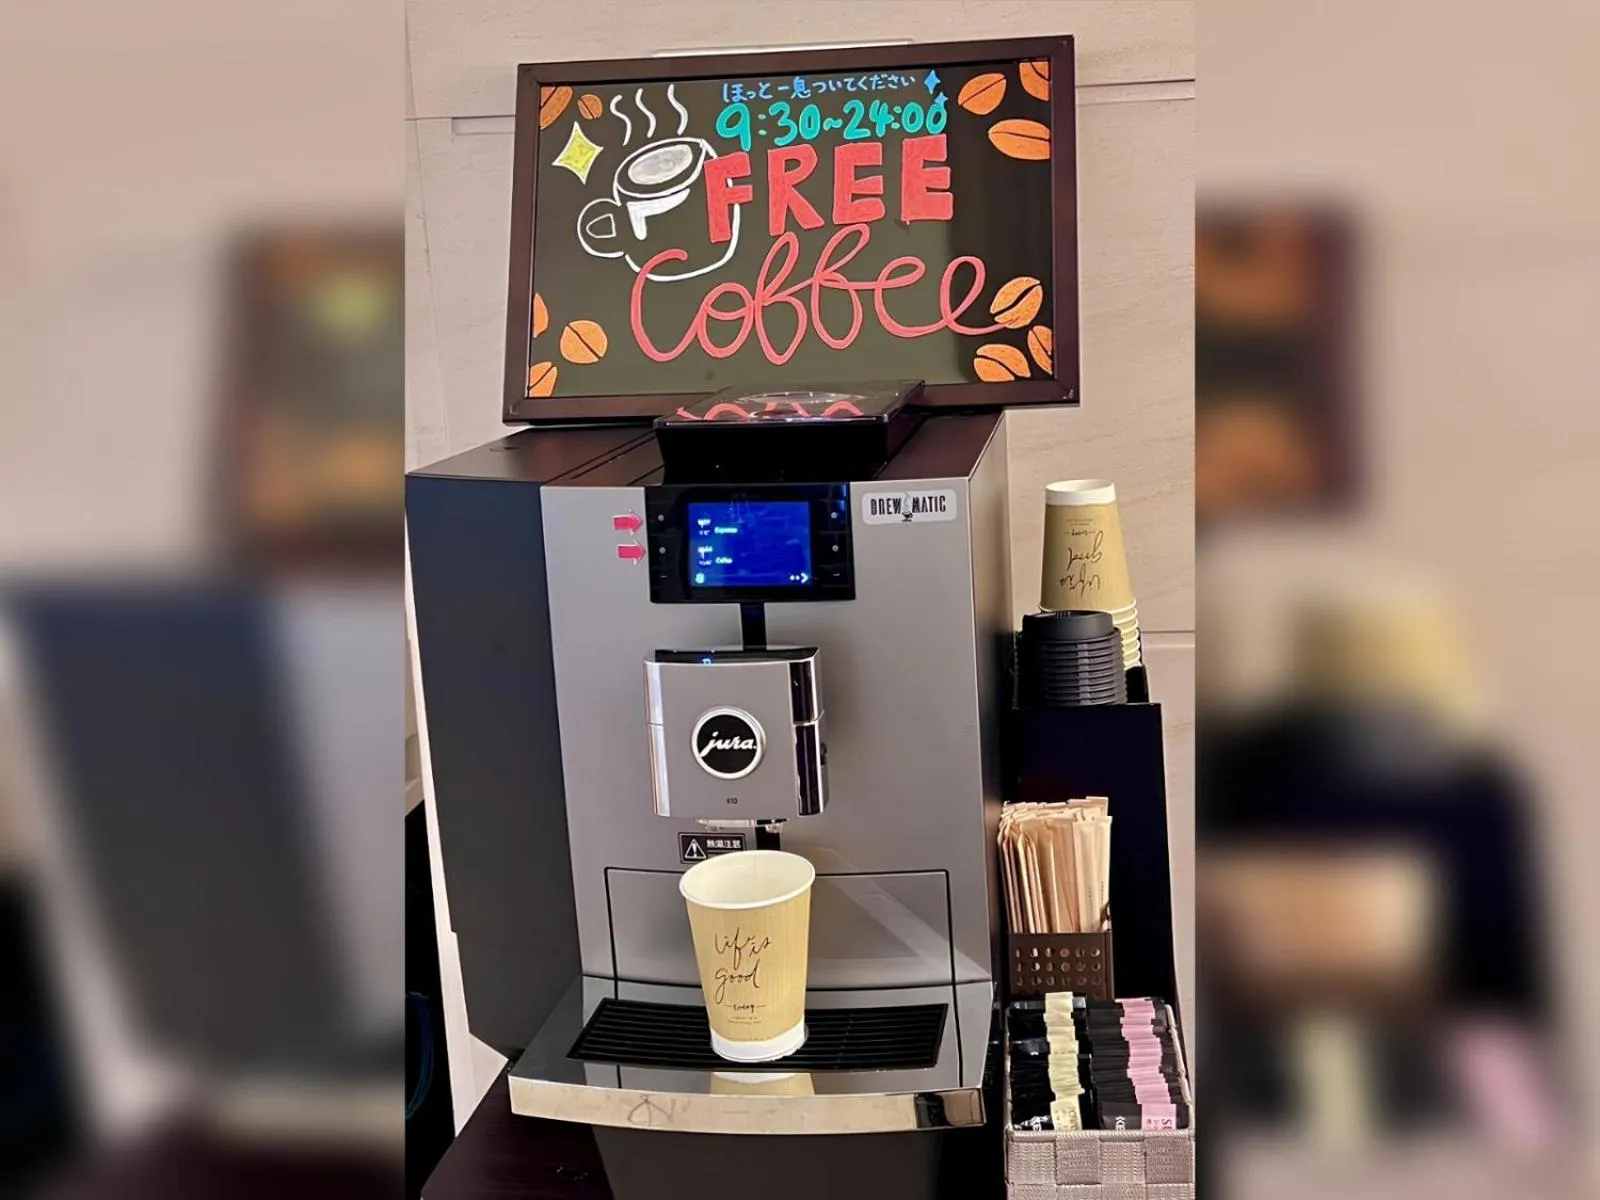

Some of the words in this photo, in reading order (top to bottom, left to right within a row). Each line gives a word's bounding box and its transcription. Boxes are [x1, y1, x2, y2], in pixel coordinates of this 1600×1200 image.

[722, 74, 916, 103] ほっと一息ついてください
[703, 133, 954, 243] FREE
[629, 222, 1012, 366] Coffee
[912, 495, 946, 513] MATIC
[715, 958, 760, 1004] good
